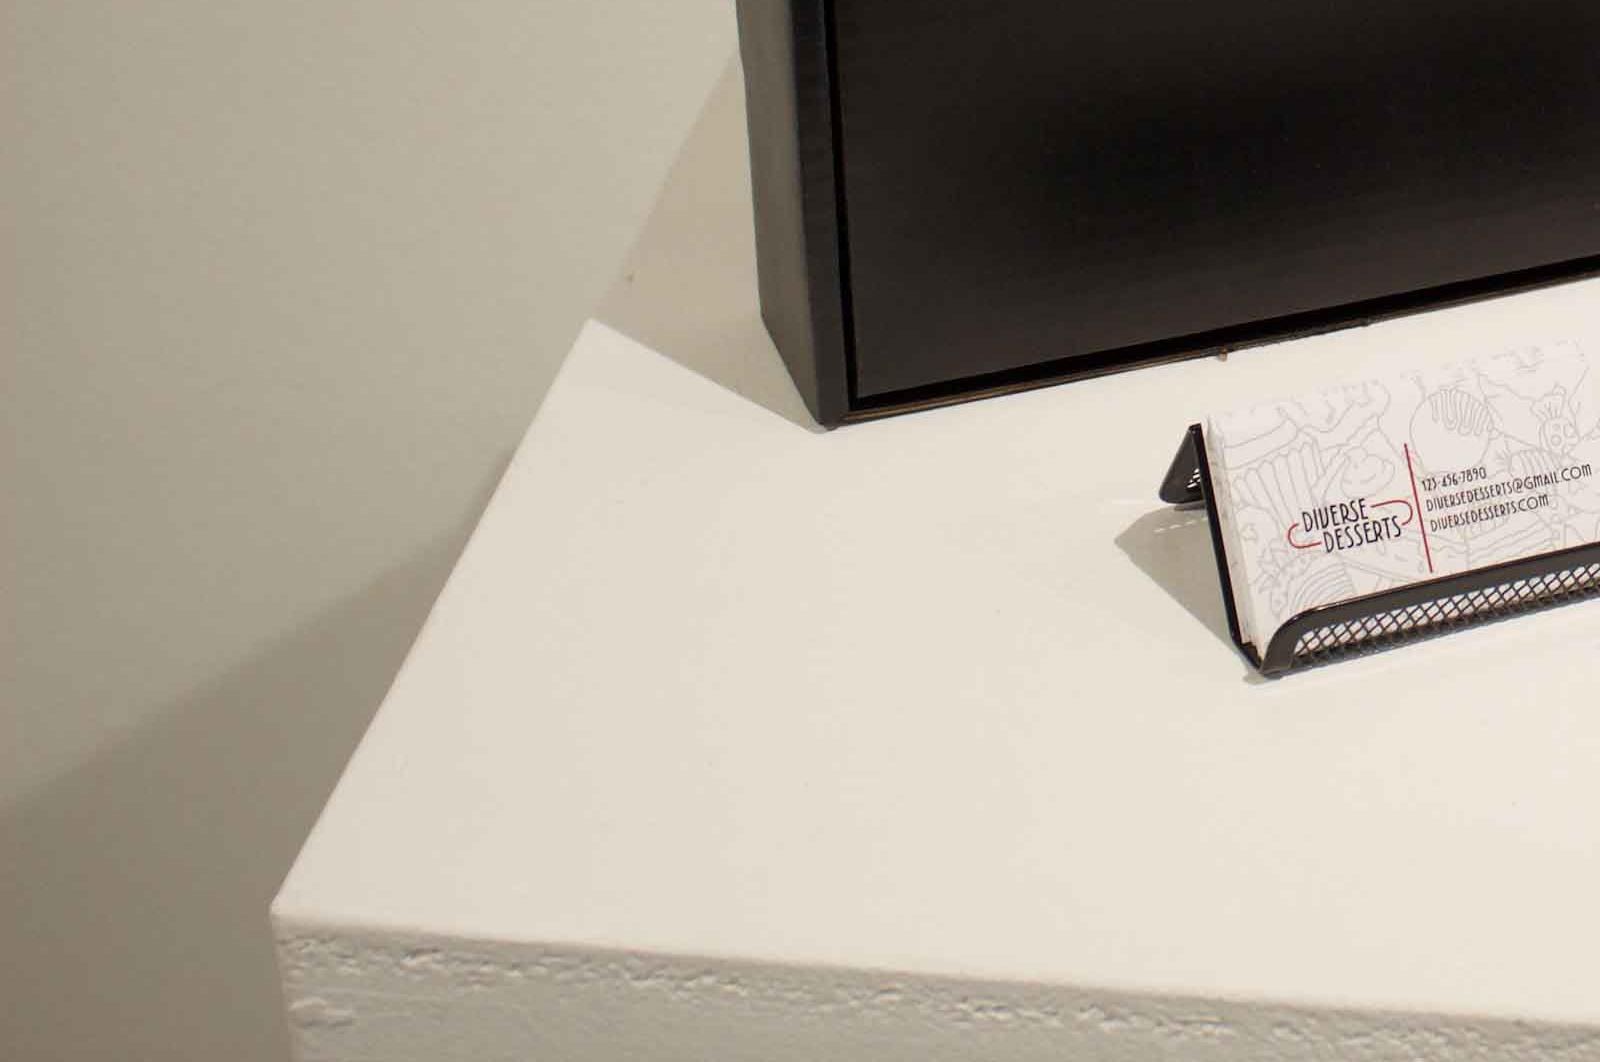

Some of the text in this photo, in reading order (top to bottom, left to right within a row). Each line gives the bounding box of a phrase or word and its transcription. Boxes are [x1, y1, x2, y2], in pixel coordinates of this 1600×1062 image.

[1422, 467, 1487, 491] 123-456-7890
[1302, 498, 1369, 533] DIVERSE
[1322, 515, 1402, 553] DESSERTS
